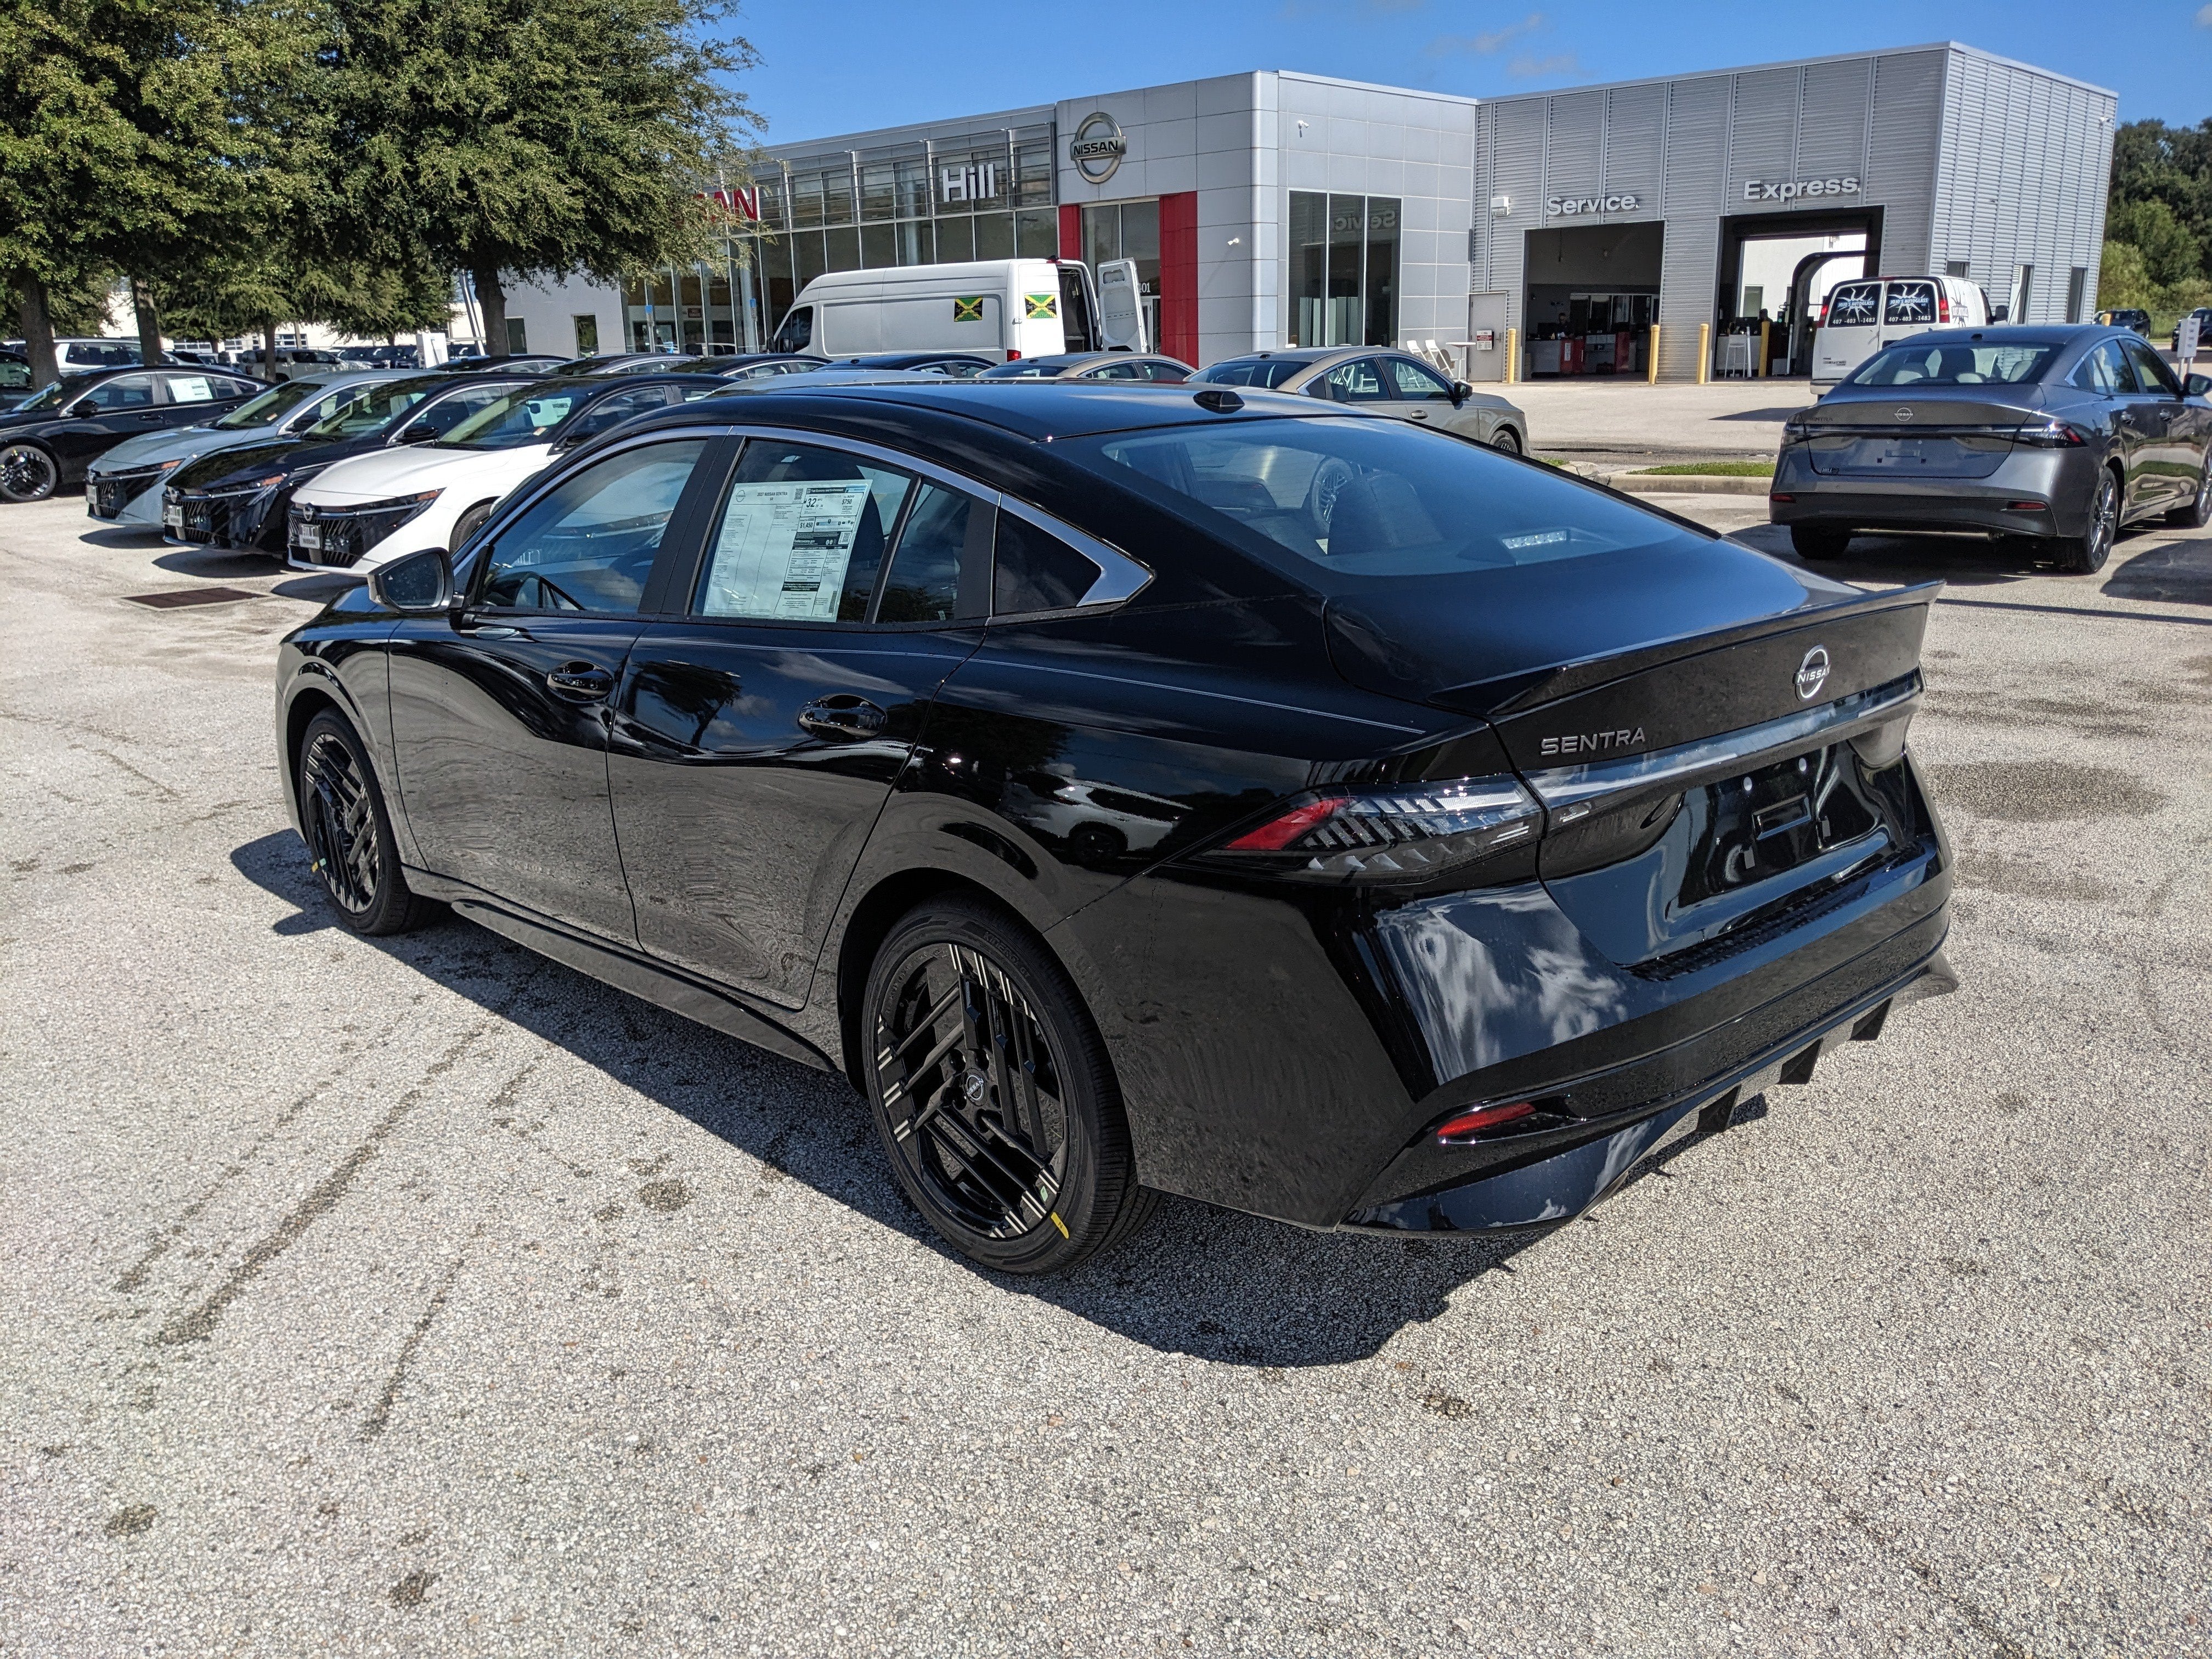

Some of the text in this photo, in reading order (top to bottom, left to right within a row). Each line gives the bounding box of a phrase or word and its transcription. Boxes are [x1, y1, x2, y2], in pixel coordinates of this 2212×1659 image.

[1074, 140, 1118, 155] NISSAN
[943, 163, 995, 202] Hill
[1743, 177, 1858, 202] Express
[1547, 194, 1636, 215] Service
[806, 498, 817, 507] 32
[1797, 666, 1830, 683] NISSAN
[1541, 727, 1645, 755] SENTRA
[967, 1078, 984, 1096] NISSAN
